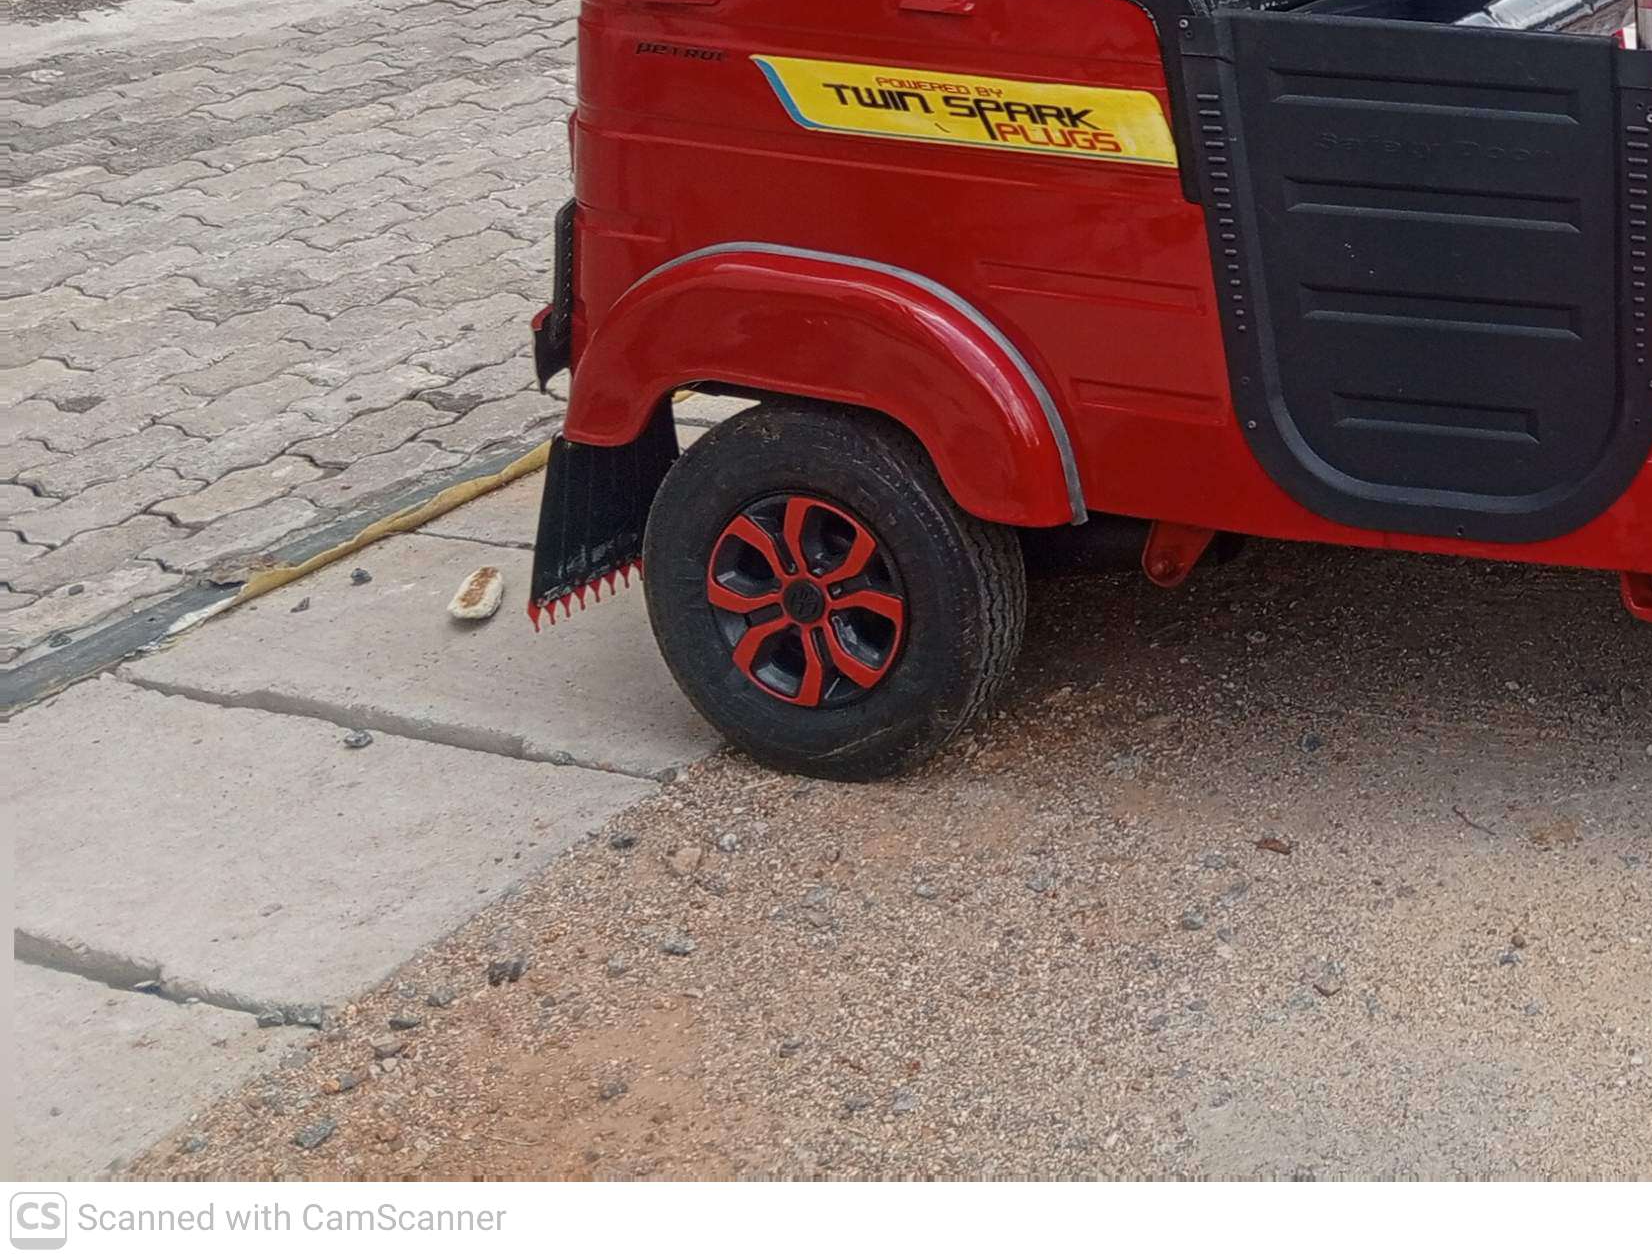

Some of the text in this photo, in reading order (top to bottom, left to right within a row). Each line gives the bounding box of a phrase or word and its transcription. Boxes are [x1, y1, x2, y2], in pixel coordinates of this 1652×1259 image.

[875, 77, 1004, 98] POWERED BY
[822, 83, 1101, 140] TWIN SPARK
[995, 123, 1122, 152] PLUGS
